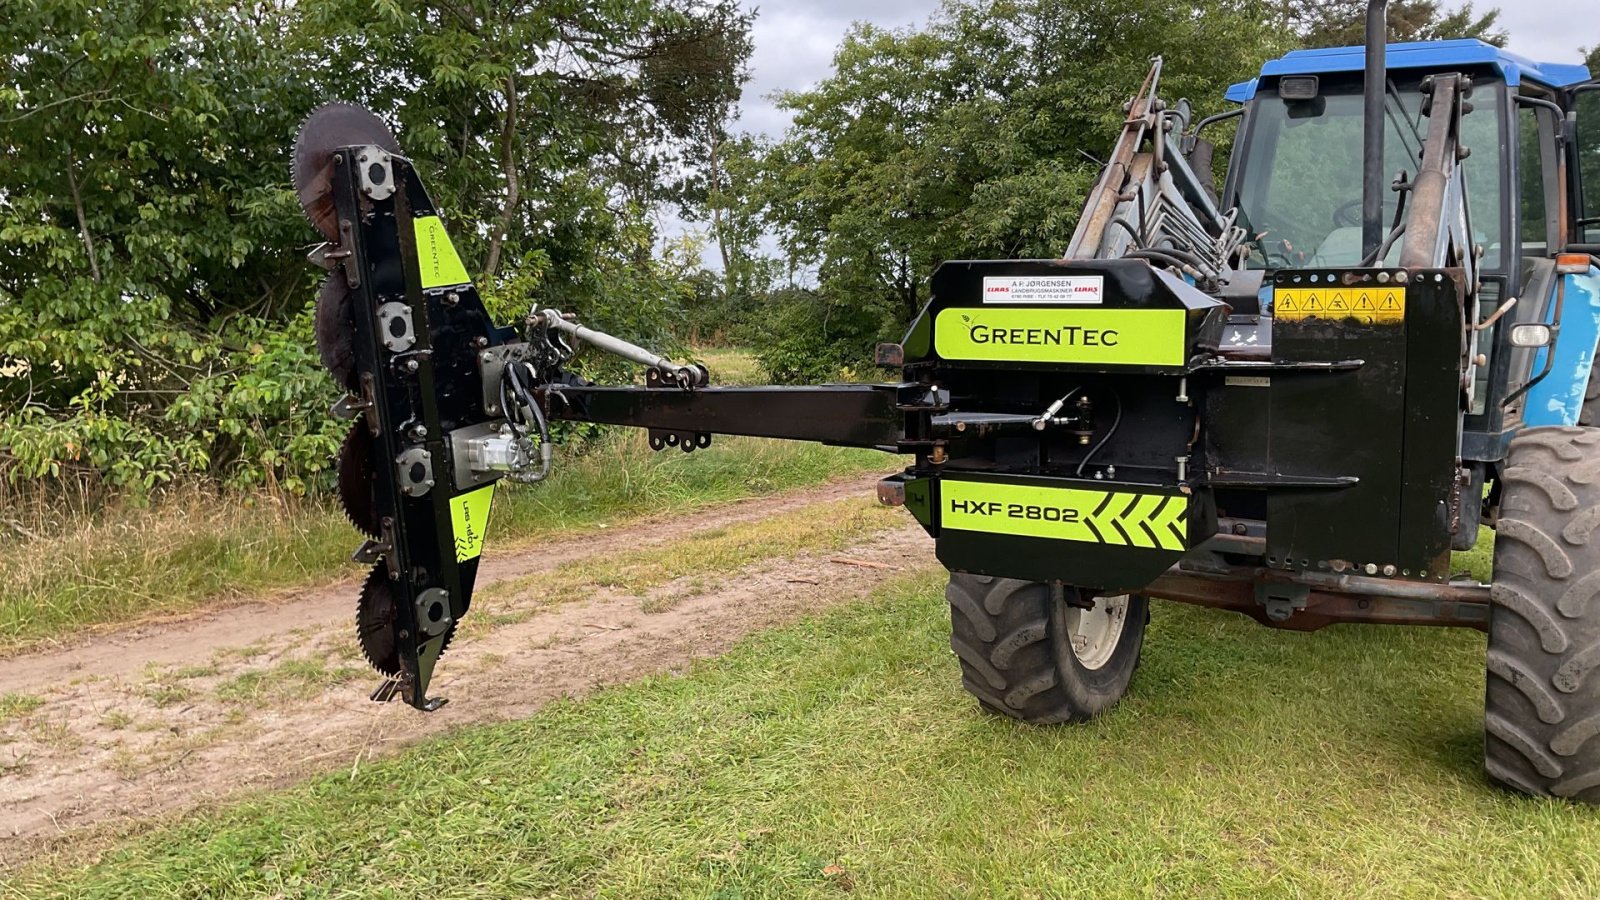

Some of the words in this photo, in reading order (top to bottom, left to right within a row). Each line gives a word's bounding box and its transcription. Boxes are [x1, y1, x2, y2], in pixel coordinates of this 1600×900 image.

[429, 225, 440, 278] GREENTEC
[970, 325, 1119, 347] GREENTEC
[951, 499, 1002, 516] HXF
[1008, 504, 1079, 523] 2802
